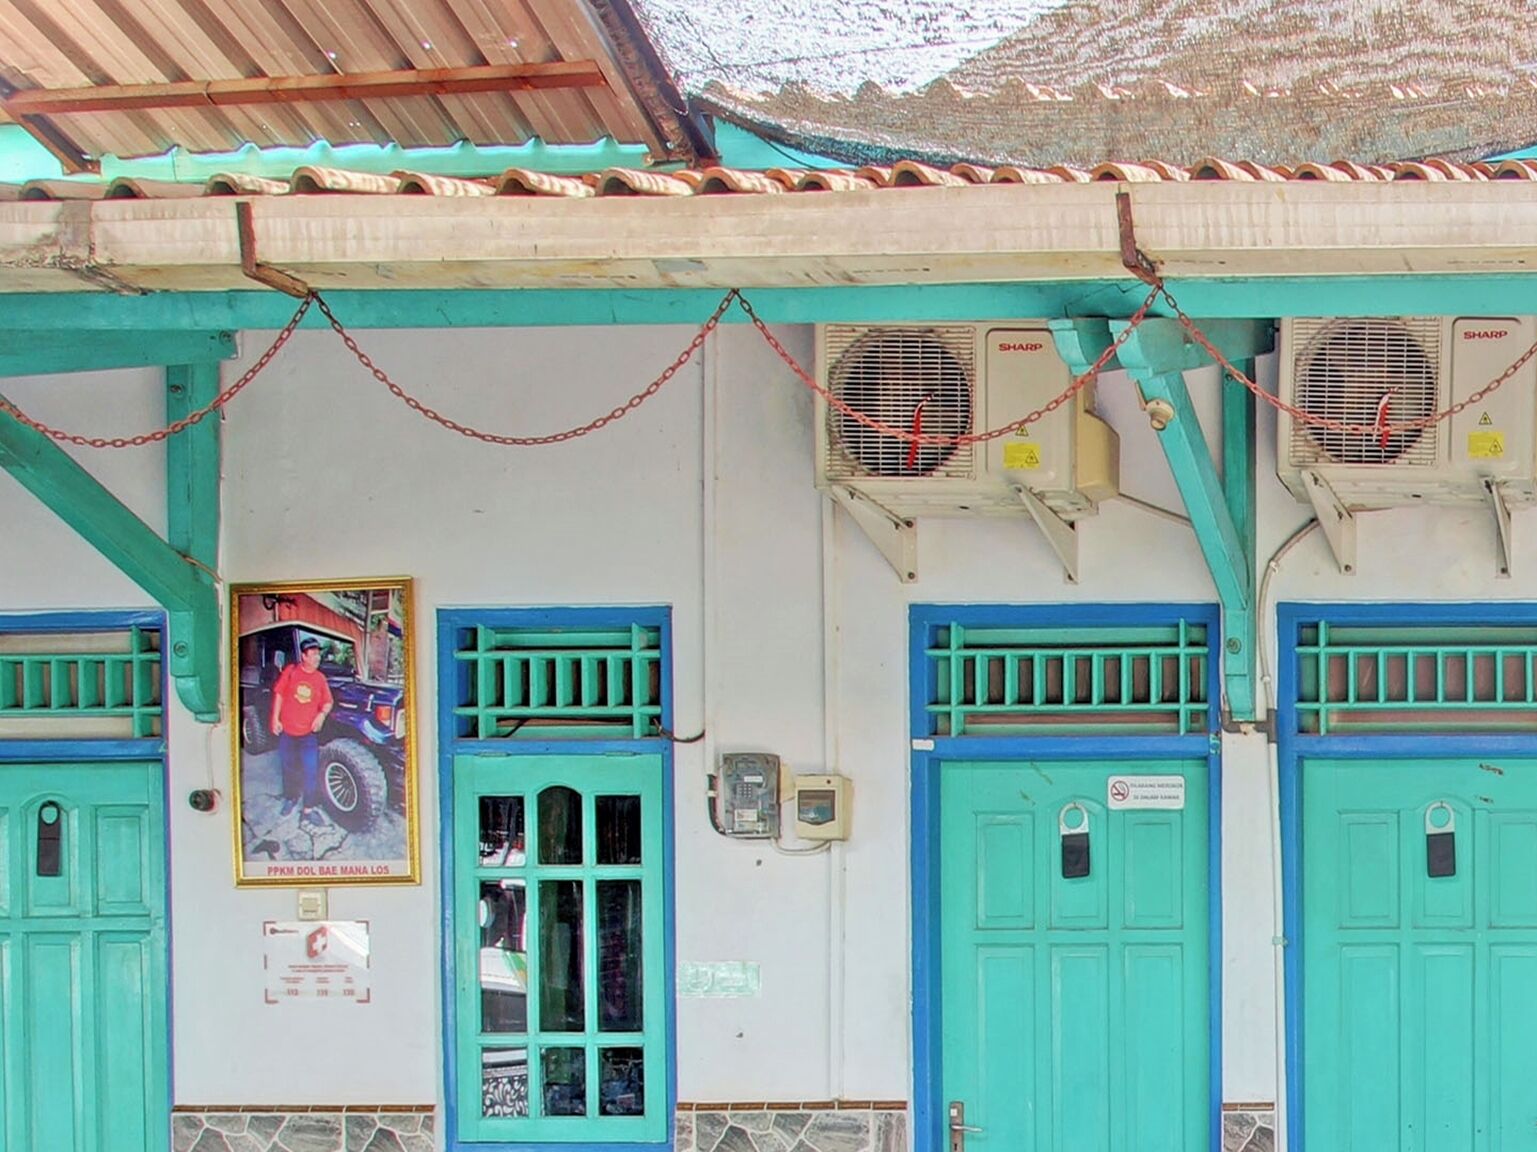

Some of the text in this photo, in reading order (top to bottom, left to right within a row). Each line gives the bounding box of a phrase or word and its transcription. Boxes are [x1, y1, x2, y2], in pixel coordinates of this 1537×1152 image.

[1463, 330, 1508, 340] SHARP
[998, 342, 1043, 352] SHARP
[267, 866, 295, 876] PPKM
[318, 866, 337, 875] BAE
[340, 866, 368, 875] MANA
[370, 865, 390, 875] LOS
